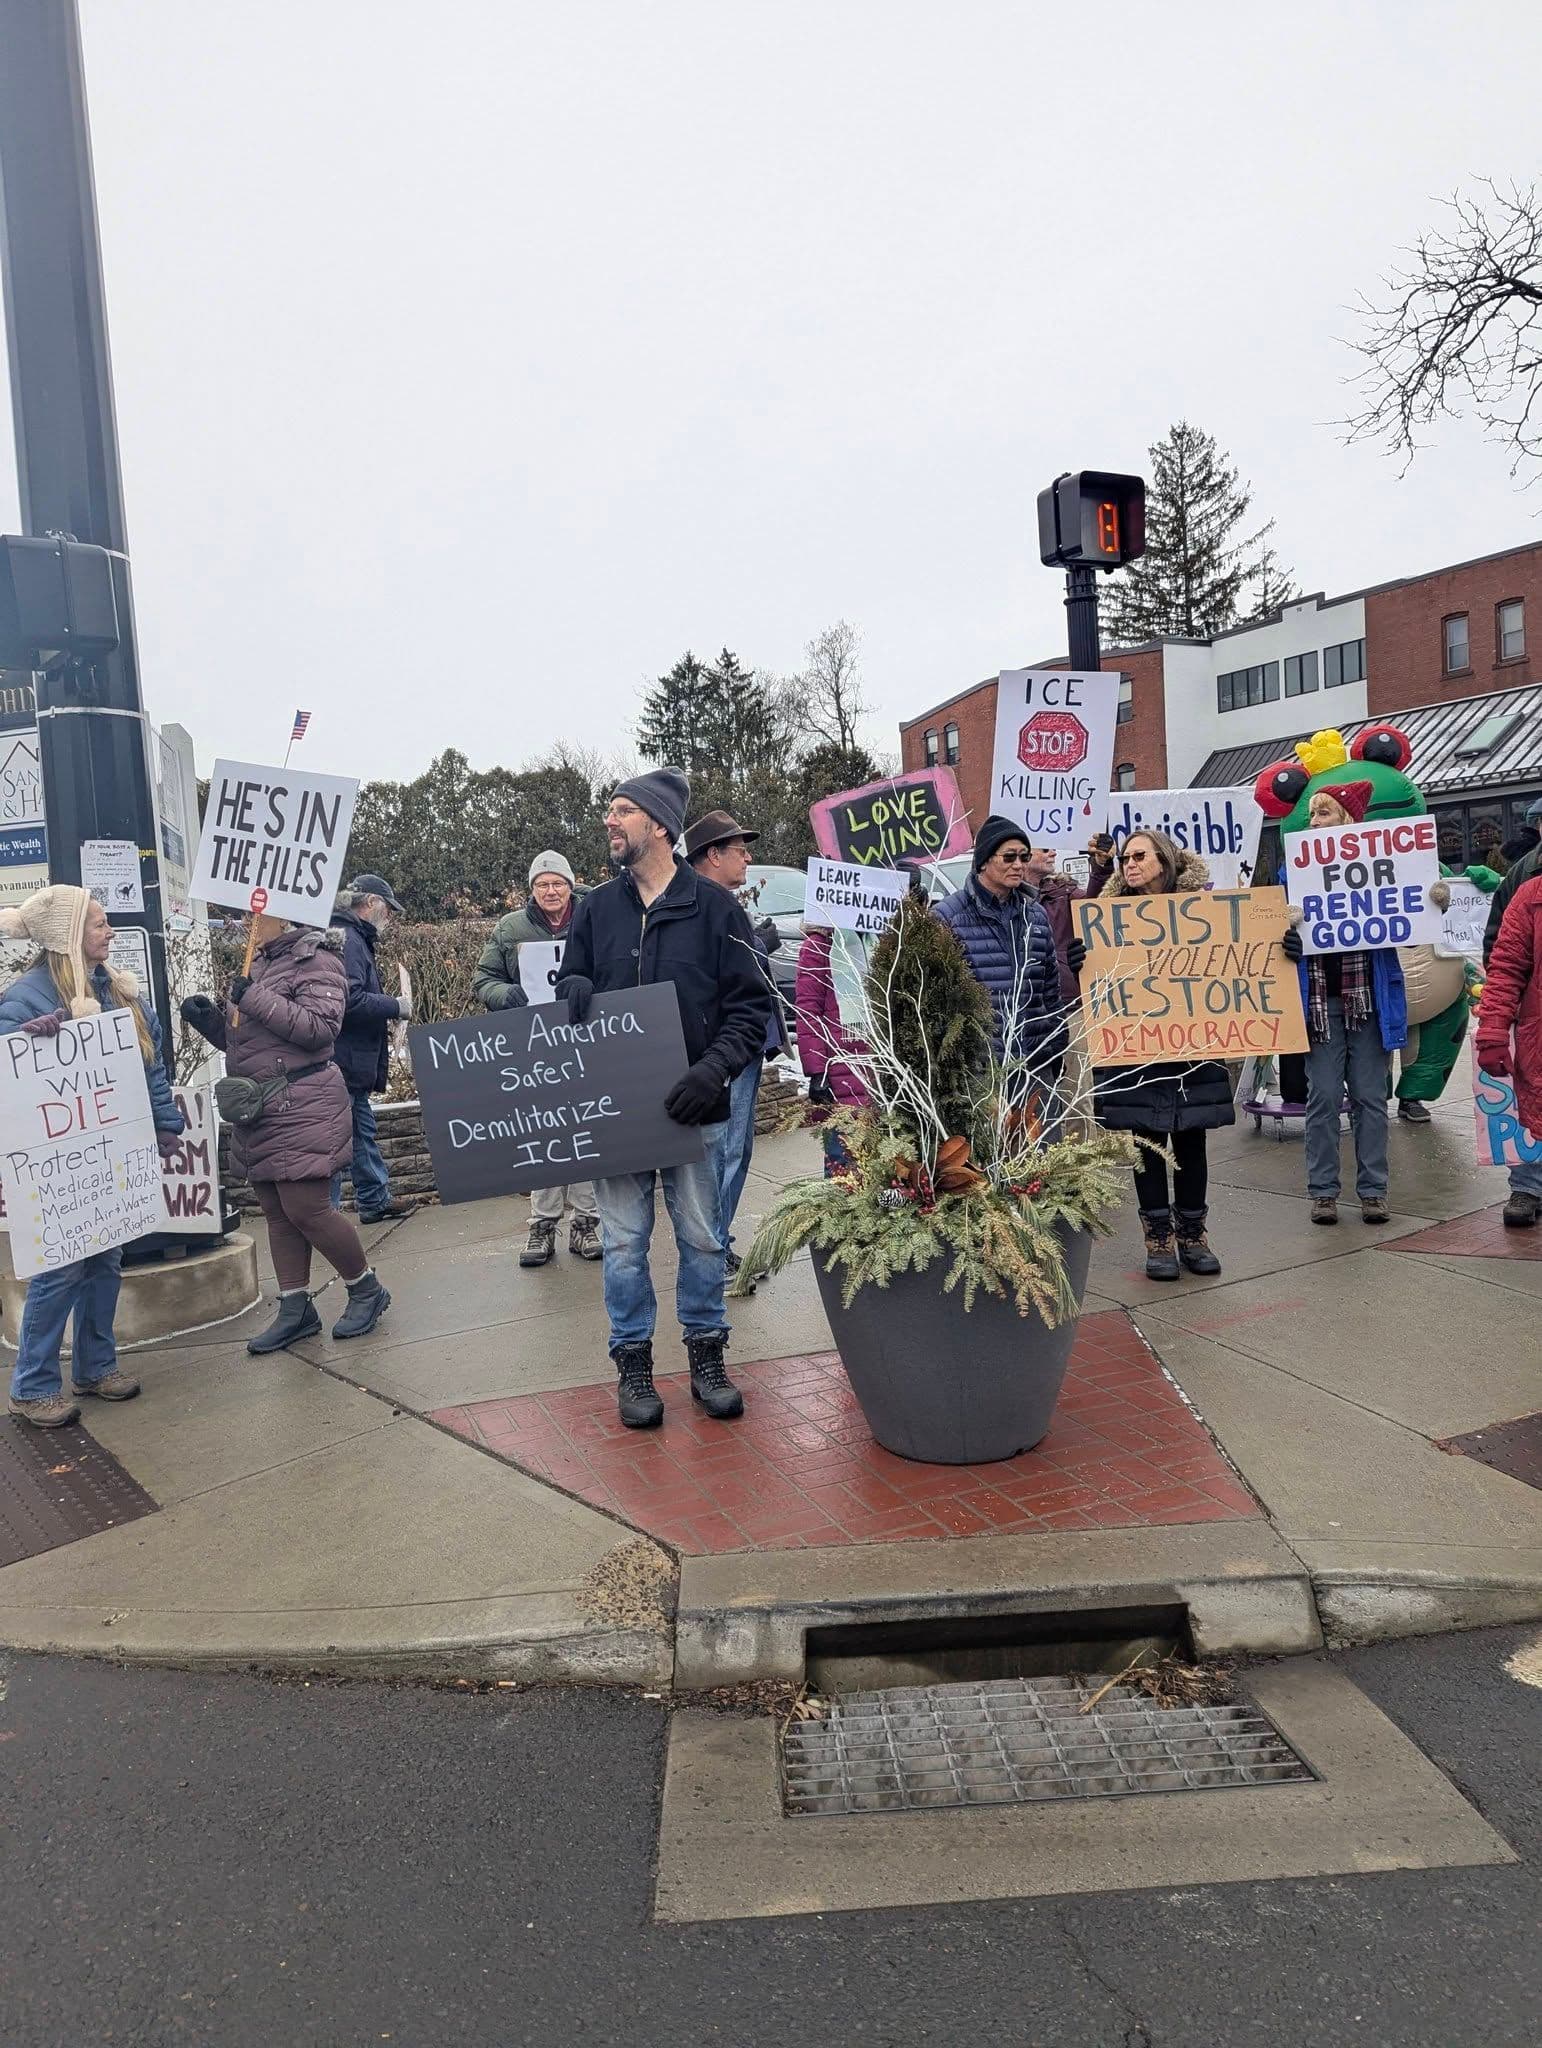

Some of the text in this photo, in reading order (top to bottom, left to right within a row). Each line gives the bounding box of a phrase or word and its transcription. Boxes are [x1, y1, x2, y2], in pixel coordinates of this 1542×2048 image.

[1025, 678, 1084, 706] ICE
[1026, 730, 1075, 756] STOP
[1001, 773, 1096, 801] KILLING
[216, 779, 288, 838] HE'S
[294, 790, 341, 848] IN
[847, 789, 926, 833] LOVE
[1025, 807, 1073, 834] US!
[11, 838, 40, 849] Wealth
[850, 815, 941, 865] WINS
[1294, 822, 1436, 868] JUSTICE
[211, 835, 257, 885] THE
[256, 843, 328, 897] FILES
[818, 867, 861, 887] LEAVE
[1322, 859, 1395, 892] FOR
[816, 887, 900, 912] GREENLAND
[1303, 885, 1424, 922] RENEE
[1079, 893, 1251, 950] RESIST
[1312, 916, 1411, 949] GOOD
[1147, 941, 1282, 977] VIOLENCE
[1090, 976, 1283, 1019] RESTORE
[7, 1014, 133, 1079] PEOPLE
[428, 1010, 645, 1069] Make America
[1101, 1017, 1280, 1055] DEMOCRACY
[45, 1068, 117, 1097] WILL
[500, 1049, 585, 1091] Safer!
[36, 1088, 119, 1139] DIE
[448, 1094, 621, 1148] Demilitarize
[7, 1135, 113, 1184] Protect
[513, 1132, 600, 1168] ICE
[38, 1159, 113, 1203] Medicaid
[126, 1170, 160, 1191] NOAA
[42, 1185, 113, 1224] Medicare
[42, 1221, 94, 1246] Clean
[94, 1207, 113, 1225] Air
[122, 1193, 156, 1212] Water
[44, 1236, 92, 1266] SNAP
[121, 1213, 156, 1237] Rights
